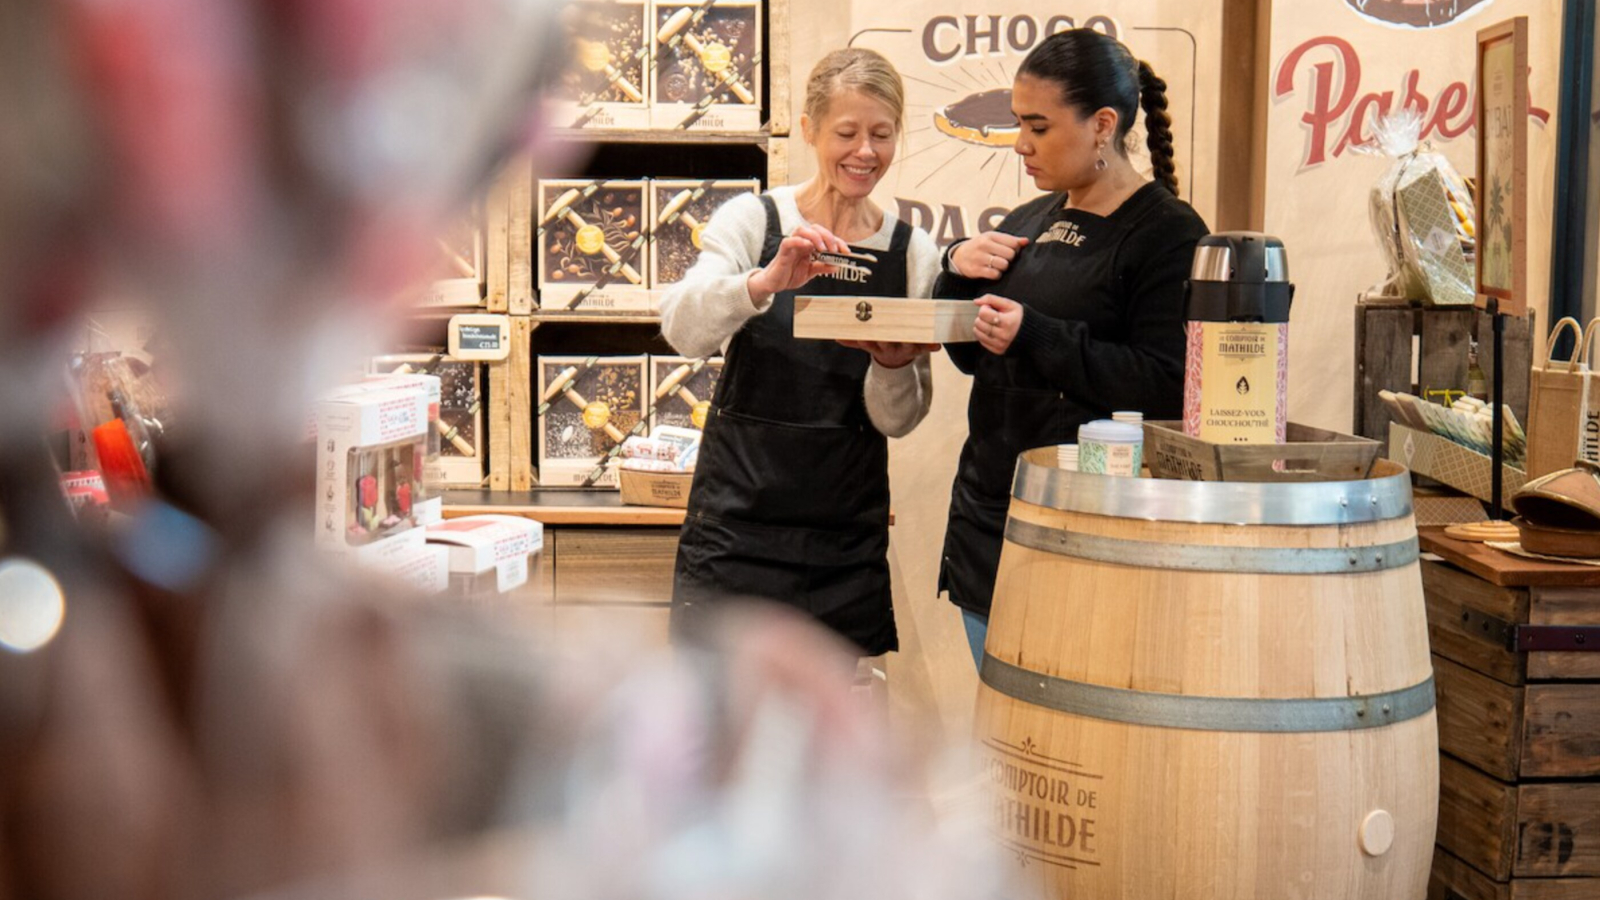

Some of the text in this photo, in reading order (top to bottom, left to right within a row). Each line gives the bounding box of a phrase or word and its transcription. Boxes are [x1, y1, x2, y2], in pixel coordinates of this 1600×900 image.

[1219, 343, 1265, 354] MATHILDE
[1210, 408, 1266, 417] LAISSEZ-VOUS
[990, 757, 1070, 807] COMPTOIR
[1076, 788, 1097, 809] DE
[994, 798, 1096, 853] THILDE
